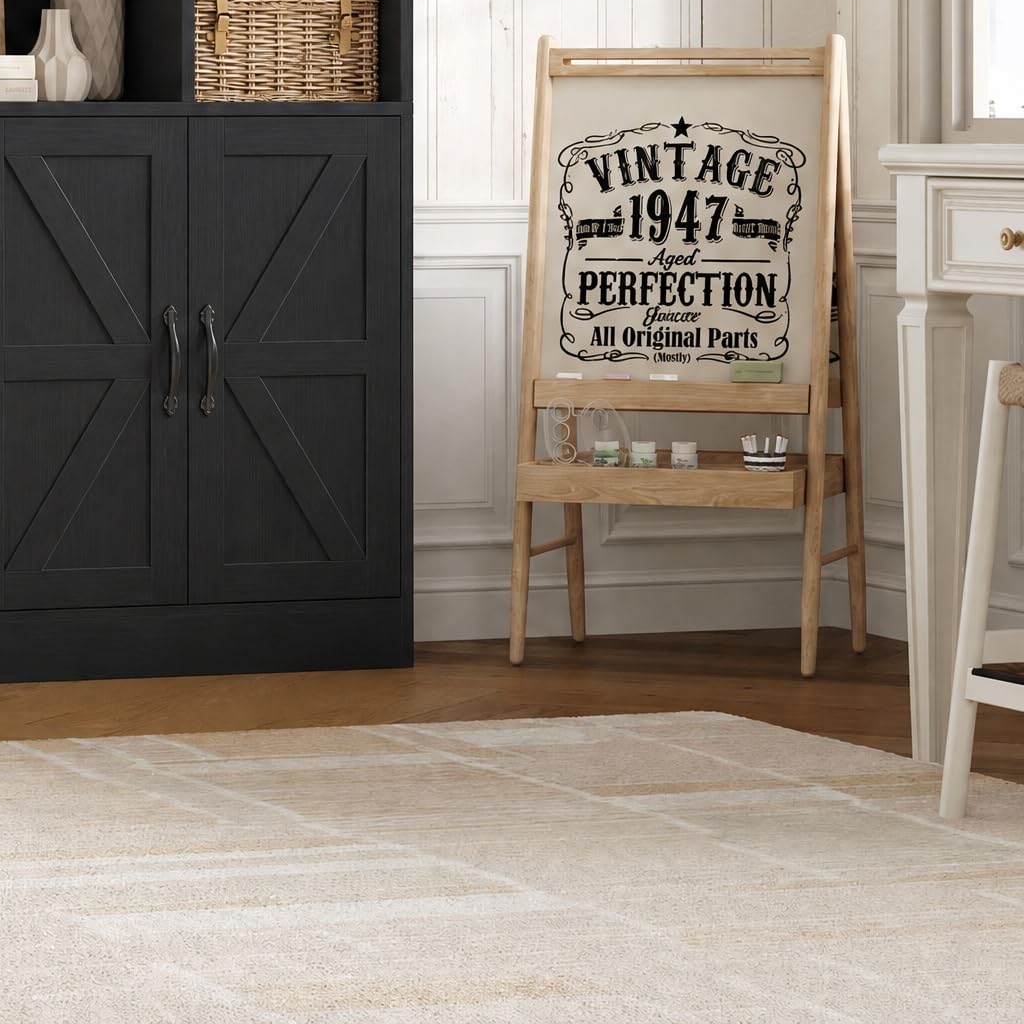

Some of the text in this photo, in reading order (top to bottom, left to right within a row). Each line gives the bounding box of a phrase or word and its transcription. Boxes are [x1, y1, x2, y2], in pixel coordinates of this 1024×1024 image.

[584, 141, 782, 197] VINTAGE
[629, 189, 729, 245] 1947
[647, 248, 700, 270] Aged
[577, 271, 777, 308] PERFECTION
[590, 326, 758, 350] All Original Parts
[653, 352, 691, 364] (Mostly)
